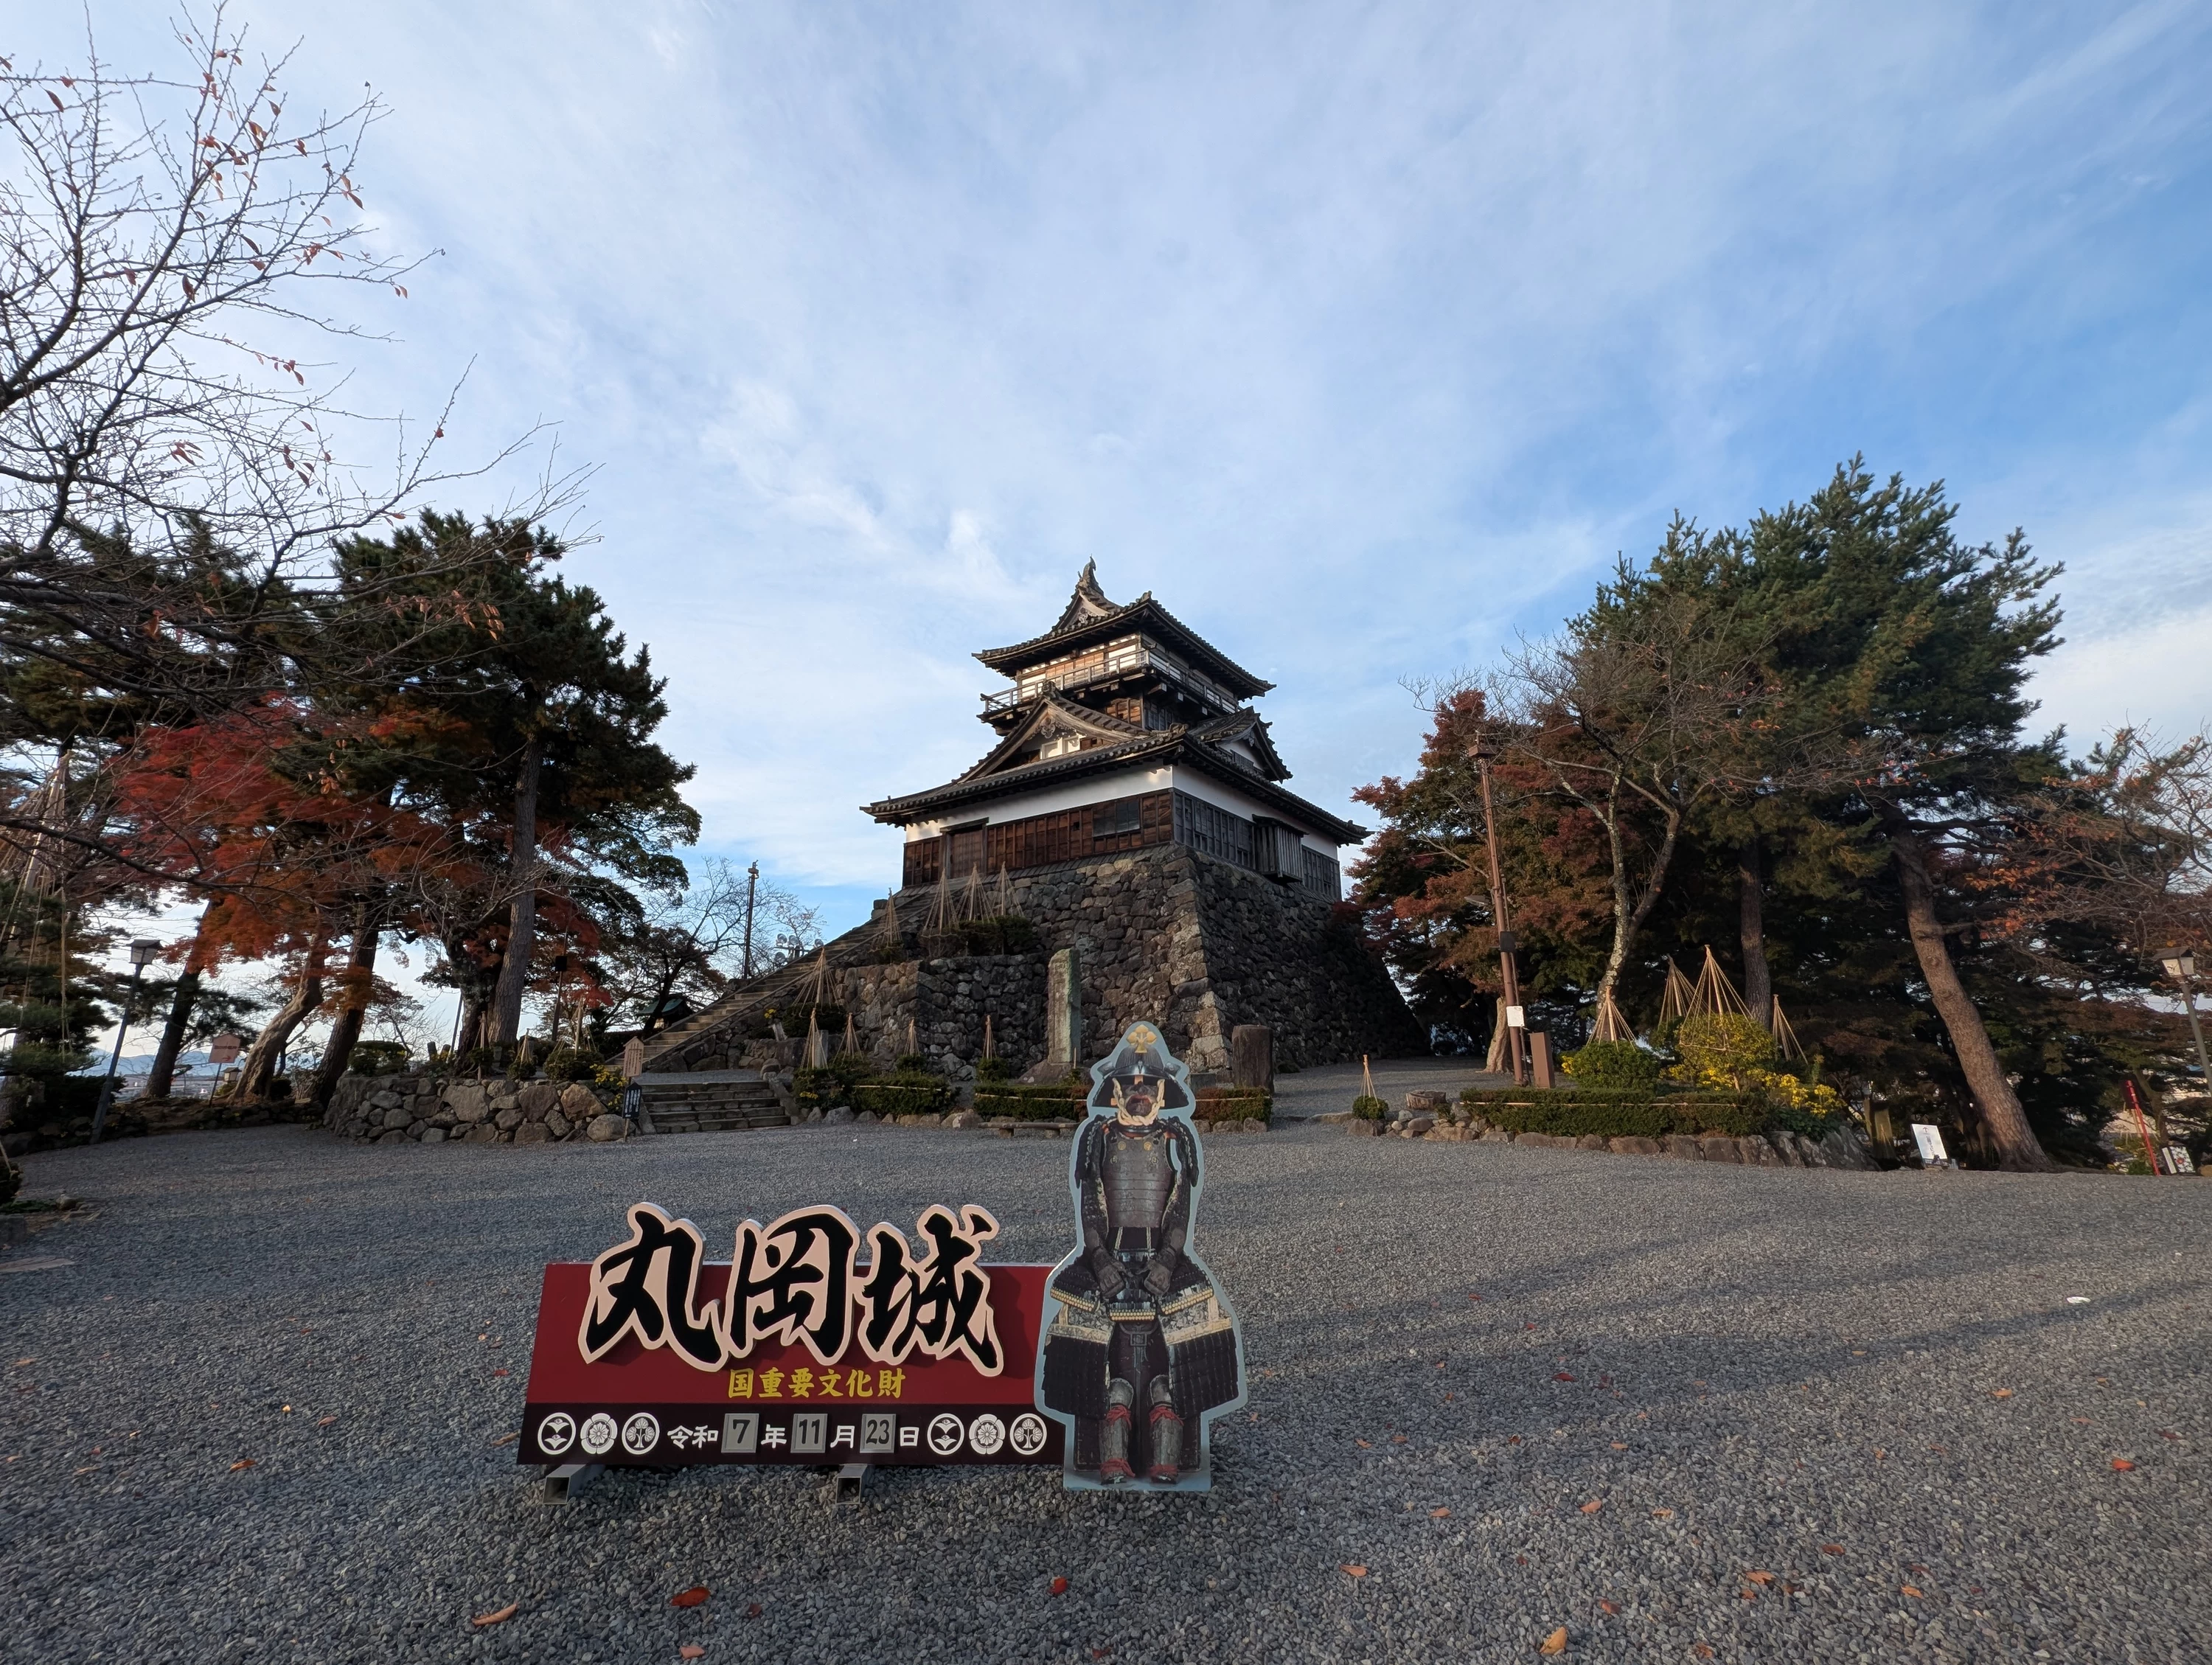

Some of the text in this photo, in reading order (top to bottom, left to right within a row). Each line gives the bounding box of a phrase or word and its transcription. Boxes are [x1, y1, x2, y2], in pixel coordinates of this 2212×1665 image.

[587, 1210, 998, 1369] 丸岡城
[728, 1367, 905, 1399] 国重要文化財
[667, 1419, 919, 1449] 令和7年11月23日
